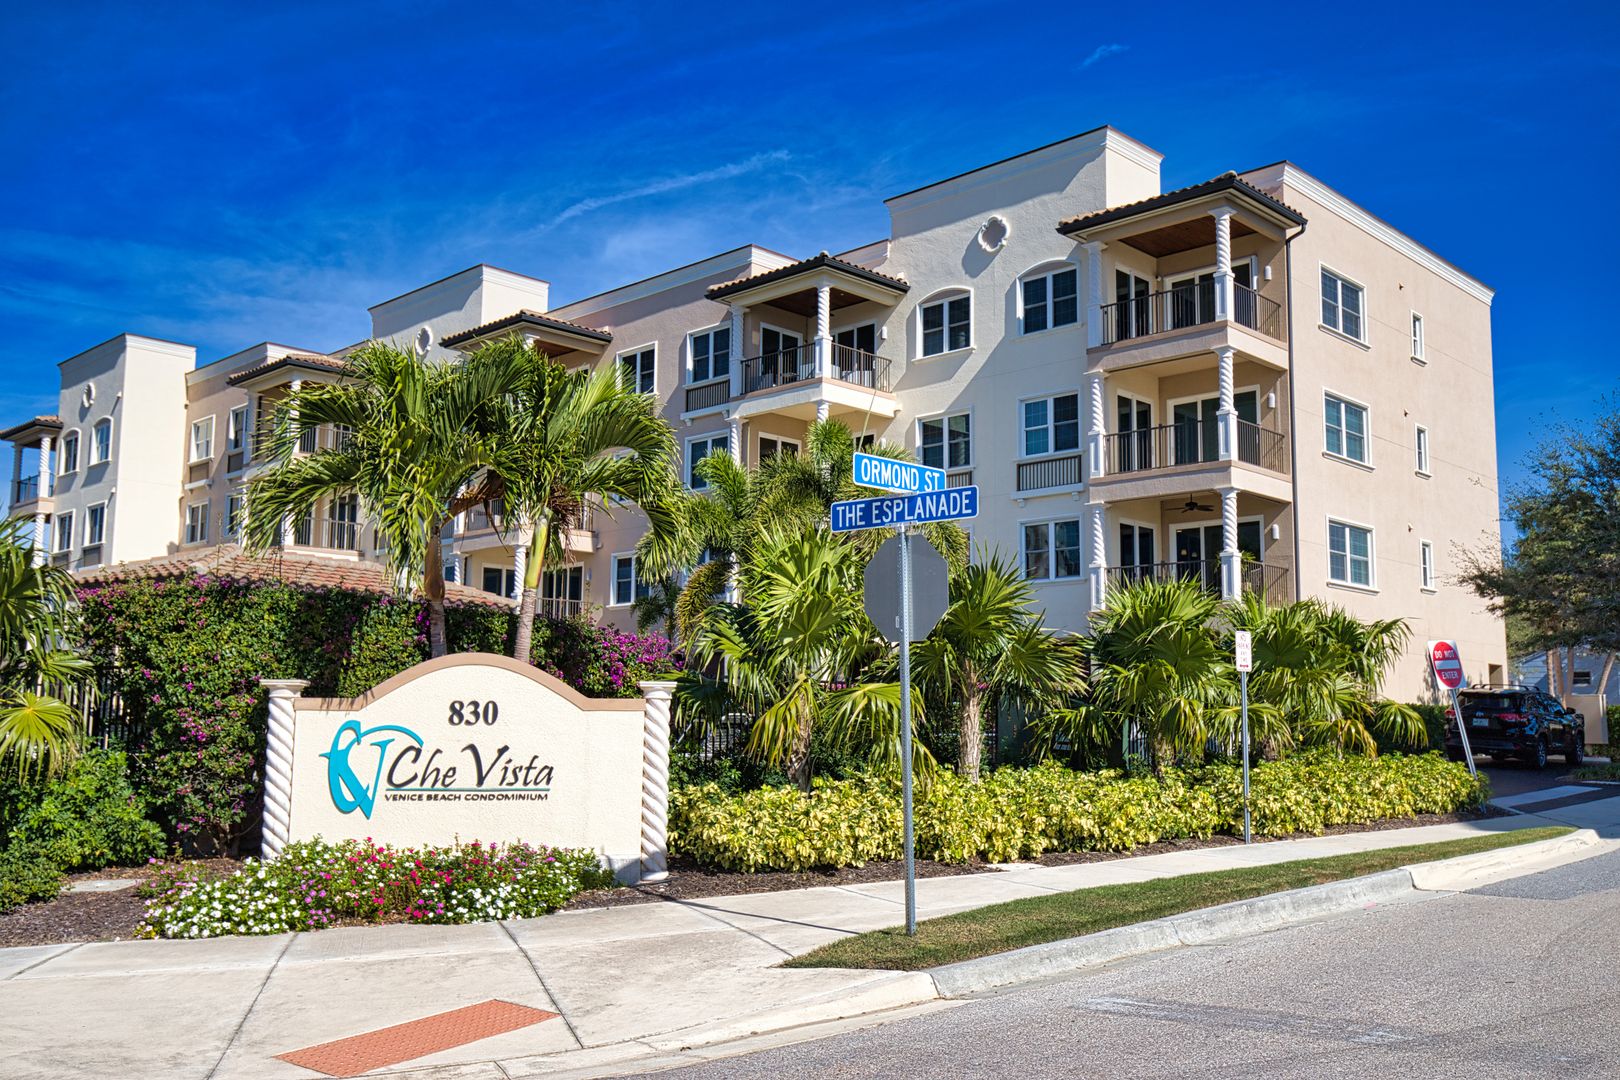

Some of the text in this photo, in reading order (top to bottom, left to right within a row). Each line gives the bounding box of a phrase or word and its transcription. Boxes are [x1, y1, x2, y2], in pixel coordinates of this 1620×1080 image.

[861, 458, 940, 492] ORMOND ST
[836, 491, 972, 528] THE ESPLANADE
[1434, 650, 1455, 659] DO NOT
[1441, 671, 1458, 679] ENTER
[448, 700, 499, 726] 830
[386, 743, 554, 789] Che Vista
[384, 793, 549, 802] VENICE BEACH CONDOMINIUM
